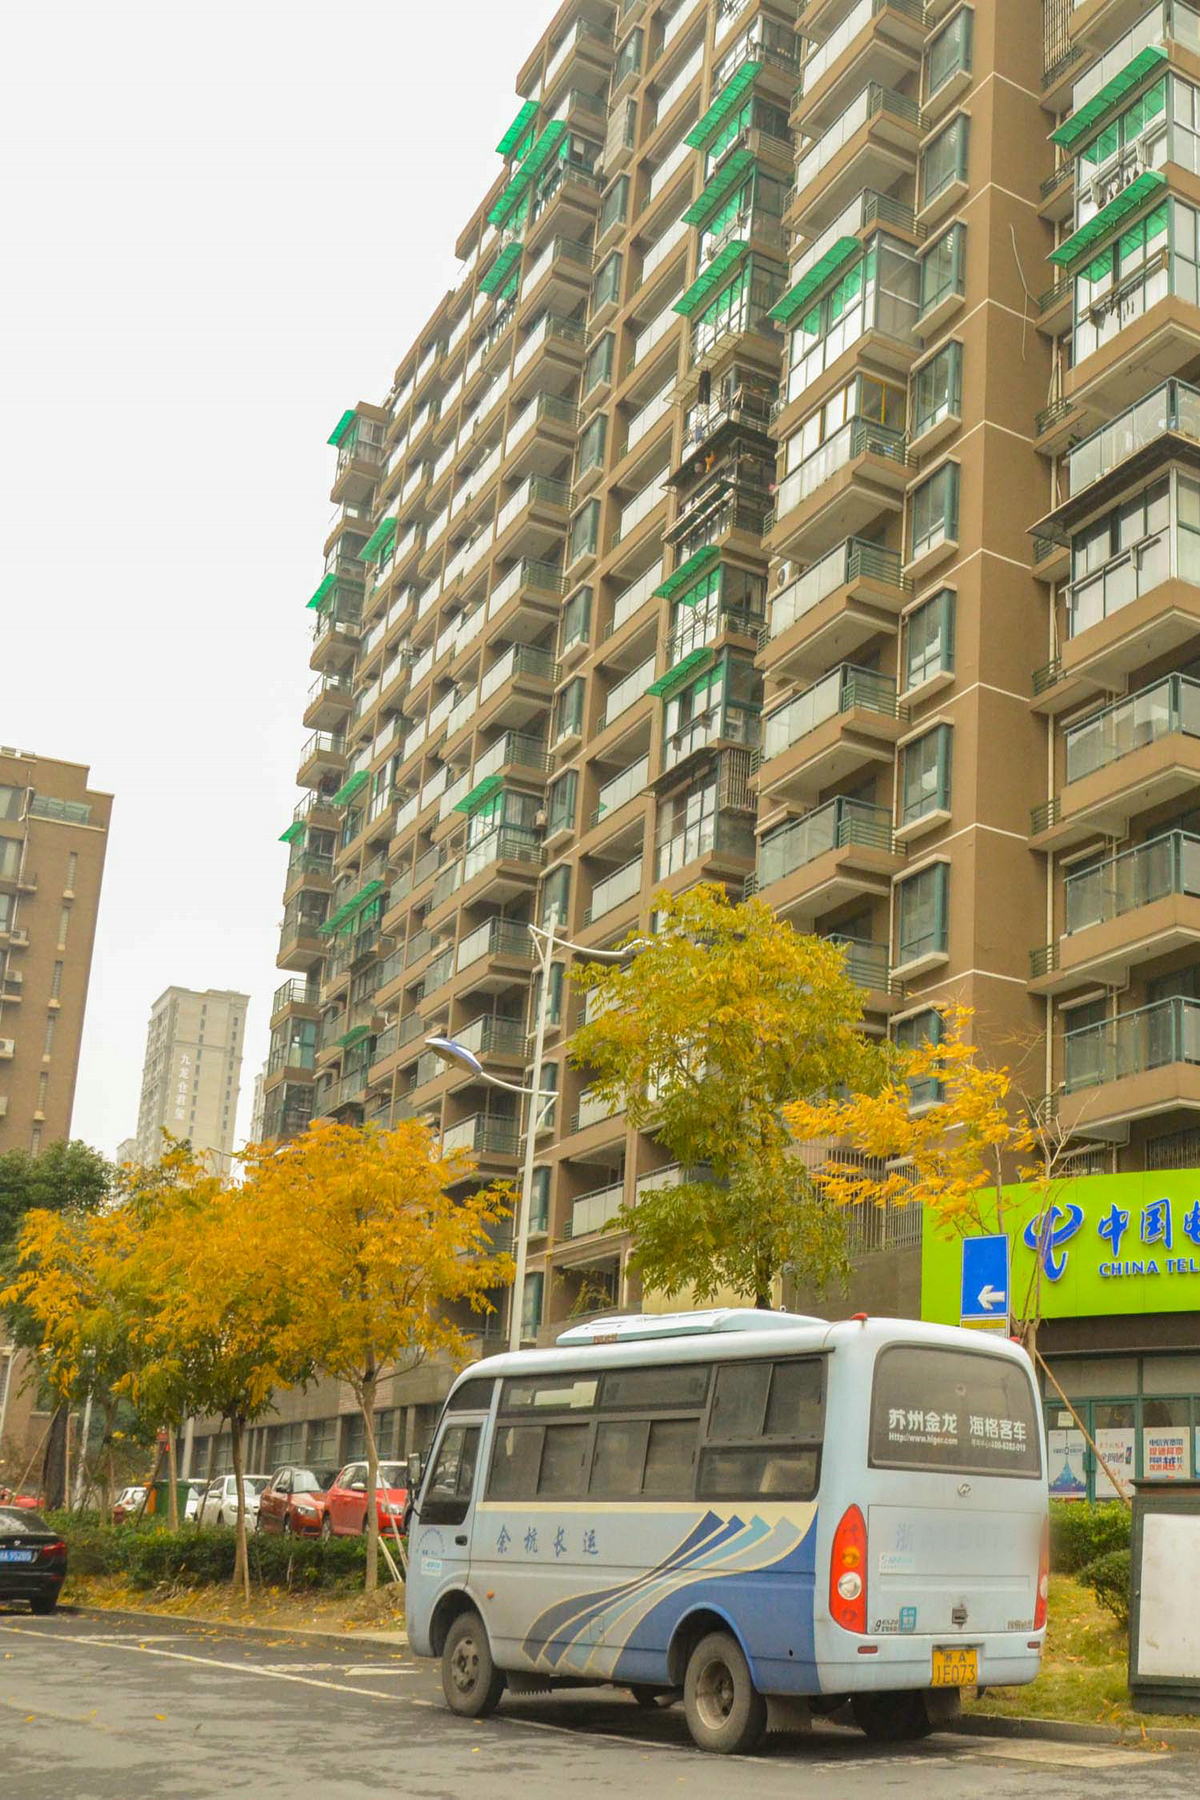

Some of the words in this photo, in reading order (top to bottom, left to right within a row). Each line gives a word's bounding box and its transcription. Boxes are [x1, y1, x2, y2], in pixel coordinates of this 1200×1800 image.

[1099, 1260, 1160, 1278] CHINA
[888, 1408, 958, 1435] 苏州金龙
[969, 1415, 1028, 1442] 海格客车
[496, 1524, 600, 1558] 余杭长运
